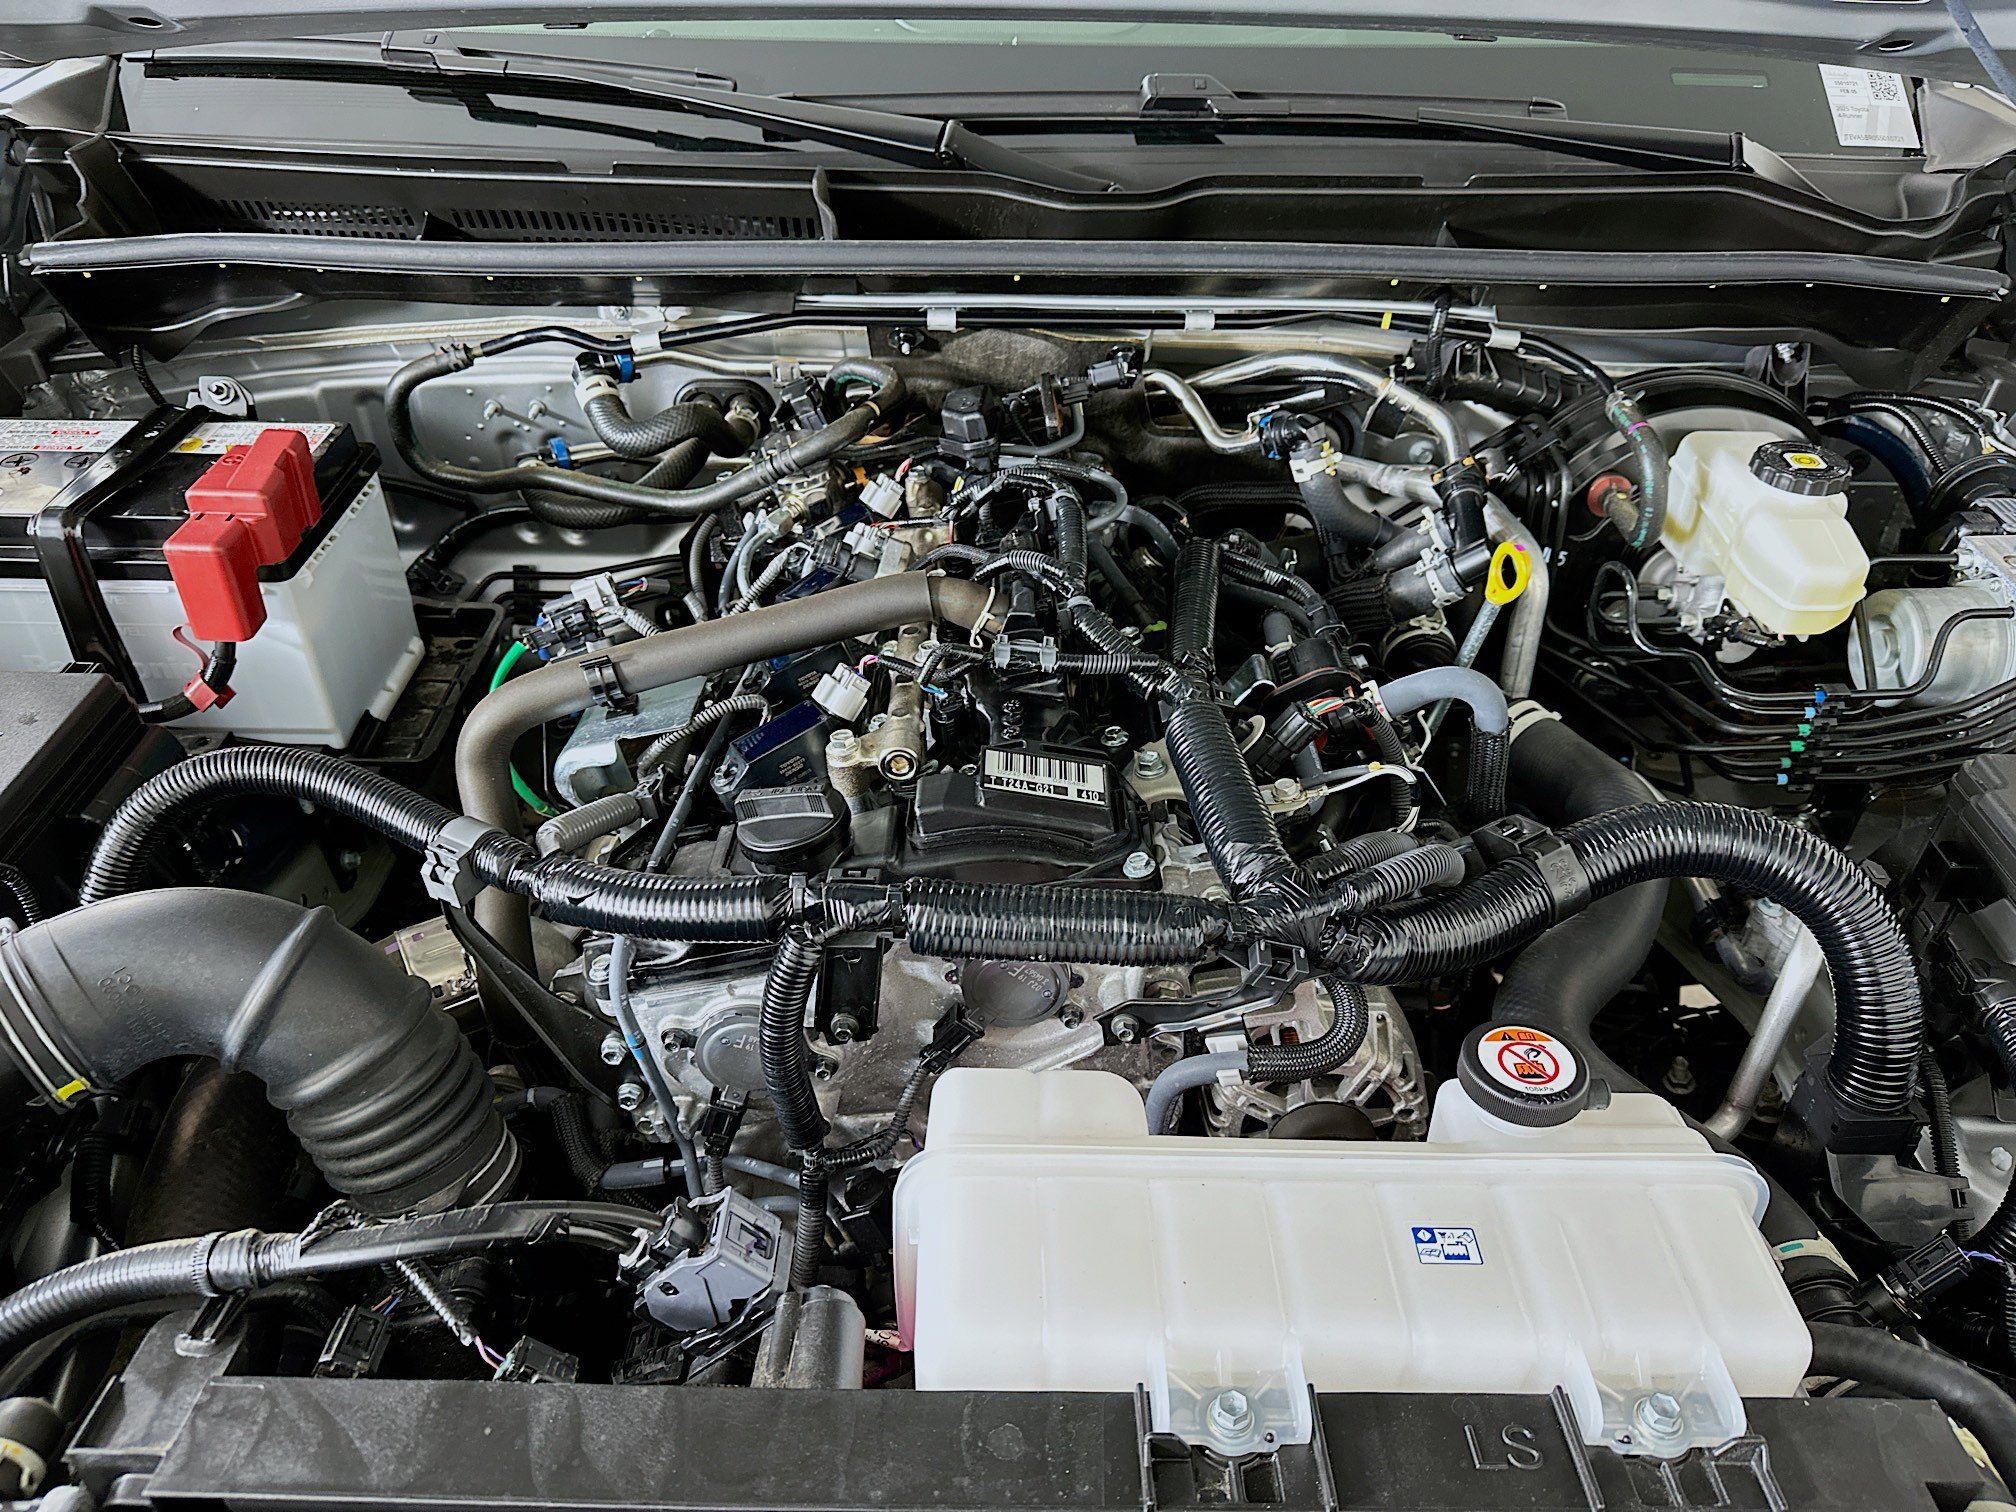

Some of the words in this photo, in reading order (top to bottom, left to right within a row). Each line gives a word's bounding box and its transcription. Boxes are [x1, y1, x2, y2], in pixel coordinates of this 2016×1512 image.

[779, 756, 802, 769] TOYOTA
[989, 775, 997, 786] T
[1002, 778, 1054, 794] T24A-G21
[1081, 790, 1099, 801] 410
[1007, 965, 1026, 977] F
[732, 1034, 746, 1048] F
[1463, 1424, 1545, 1470] LS
